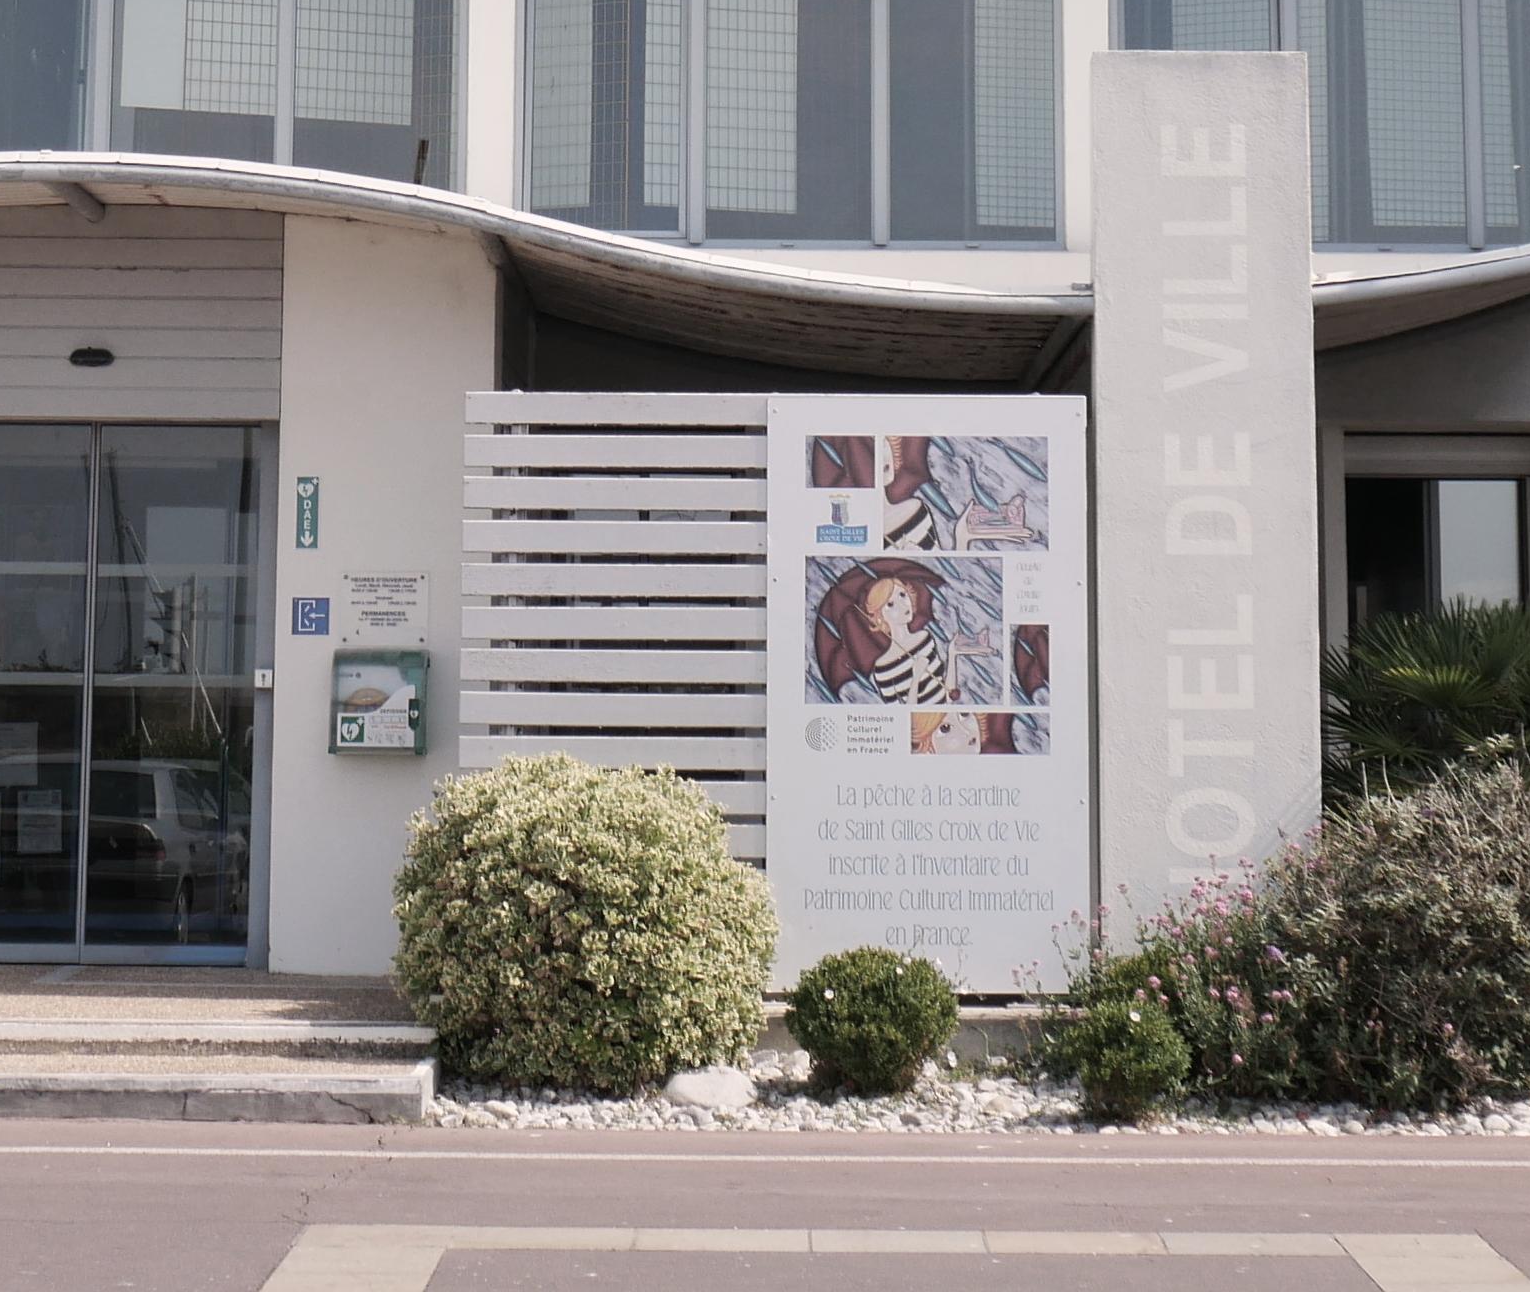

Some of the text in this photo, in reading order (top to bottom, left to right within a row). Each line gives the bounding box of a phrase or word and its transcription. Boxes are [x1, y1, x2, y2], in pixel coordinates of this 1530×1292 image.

[1160, 123, 1249, 392] VILLE
[1165, 432, 1253, 555] DE
[303, 499, 312, 530] DAE
[846, 714, 894, 723] Patrimoine
[846, 725, 882, 733] Culturel
[846, 735, 894, 744] Immatériel
[860, 746, 889, 754] France
[836, 784, 1021, 809] La pêche à la sardine
[818, 819, 1040, 842] de Saint Gilles Croix de Vie
[828, 853, 890, 876] inscrite
[895, 854, 906, 876] à
[1006, 855, 1029, 877] du
[804, 888, 1054, 912] Patrimoine Culturel Immatériel
[885, 925, 907, 946] en
